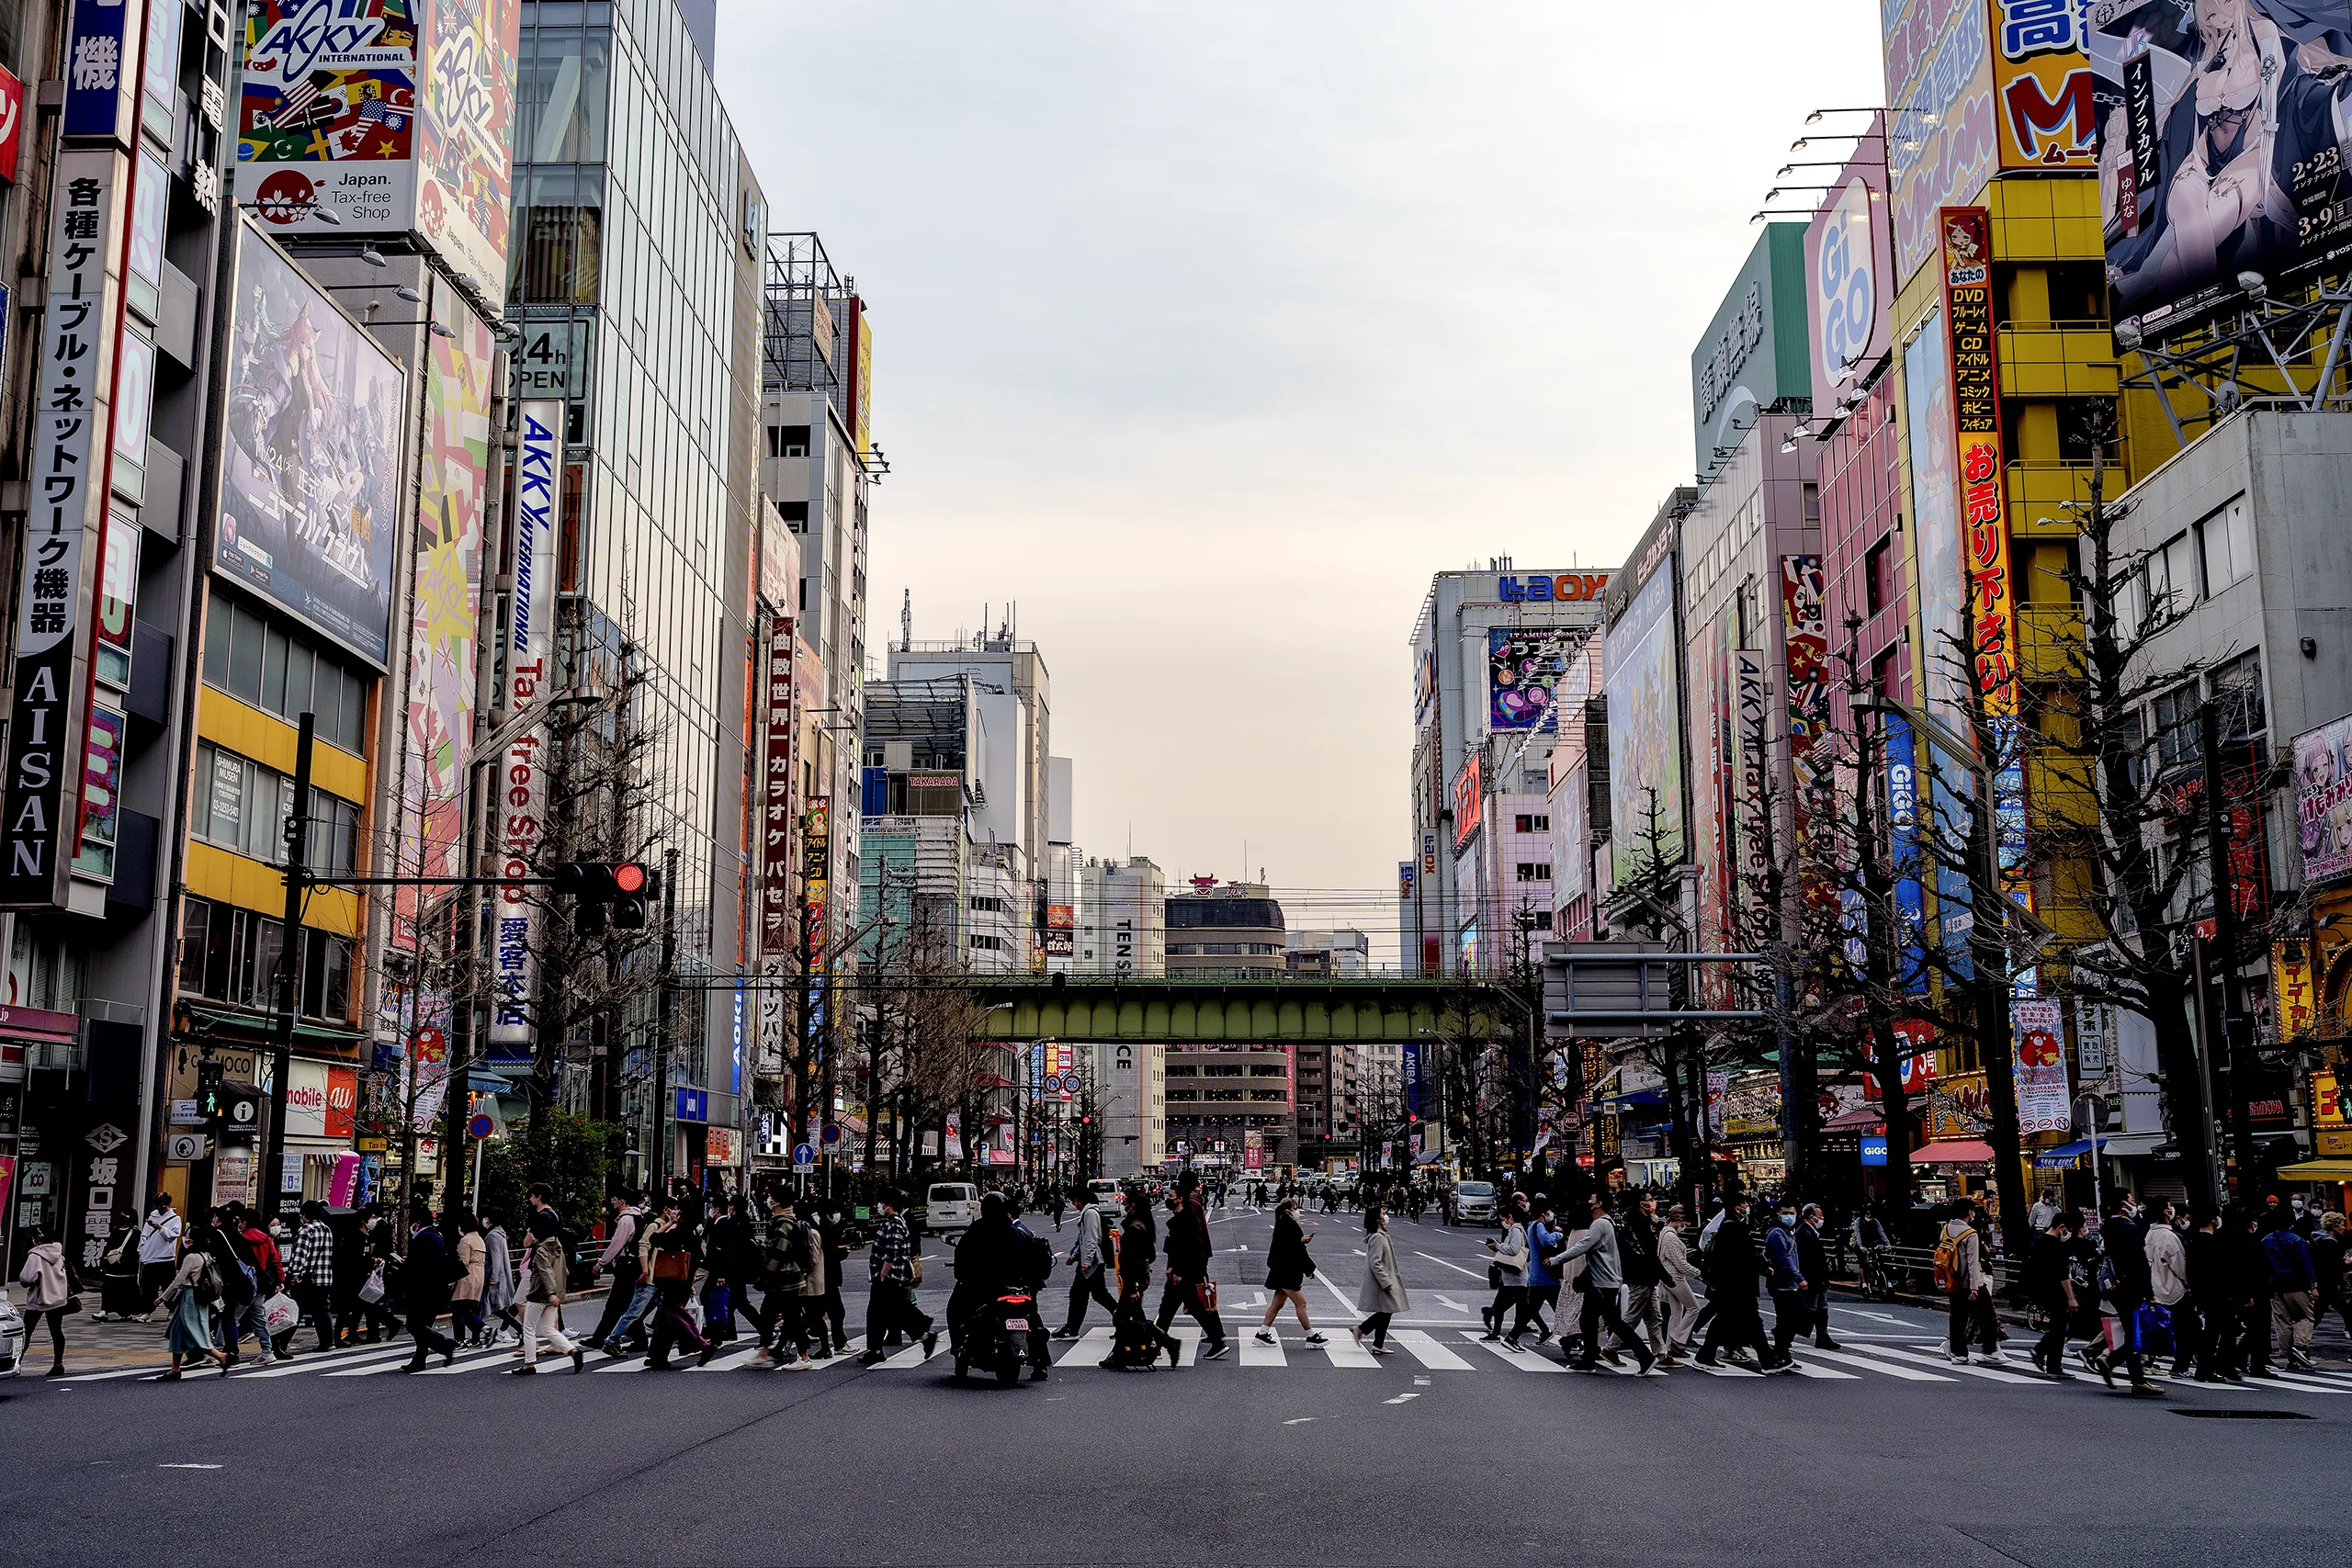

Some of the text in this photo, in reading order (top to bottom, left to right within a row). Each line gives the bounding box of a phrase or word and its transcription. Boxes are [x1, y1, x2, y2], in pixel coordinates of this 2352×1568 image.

[258, 1, 376, 83] AKKY
[319, 53, 404, 62] INTERNATIONAL
[2130, 63, 2156, 186] インプラカブル
[463, 110, 502, 168] INTERNATIONAL
[339, 173, 391, 188] Japan.
[332, 190, 391, 204] Tax-free
[2121, 178, 2135, 220] ゆかな
[352, 206, 390, 221] Shop
[467, 246, 488, 282] Tax-free
[488, 272, 502, 298] Shop
[1950, 268, 1984, 284] あなたの
[1953, 289, 1984, 302] DVD
[1952, 306, 1987, 319] ブルーレイ
[1954, 321, 1988, 334] ゲーム
[1962, 337, 1983, 350] CD
[1956, 354, 1989, 366] アイドル
[1957, 369, 1991, 382] アニメ
[1960, 385, 1991, 398] コミック
[30, 177, 103, 634] 各種ケーブル・ネットワーク機器
[1962, 401, 1991, 414] ホビー
[1962, 419, 1993, 431] フィギュア
[514, 413, 553, 655] AKKY INTERNATIONAL
[1637, 526, 1668, 586] ビックカメラ
[1739, 654, 1762, 738] AKKY
[10, 666, 58, 877] AISAN
[216, 756, 242, 774] SHIMURA
[219, 769, 239, 784] MUSEN
[909, 776, 959, 787] TAKARADA
[807, 852, 826, 863] アニメ
[809, 867, 822, 878] CD
[766, 860, 786, 931] パセラ
[732, 990, 743, 1068] AOKI
[1406, 1051, 1417, 1086] AKIBA
[1067, 1080, 1079, 1089] 50
[2026, 1084, 2066, 1092] AKIHABARA
[286, 1086, 322, 1106] mobile
[330, 1087, 353, 1110] au
